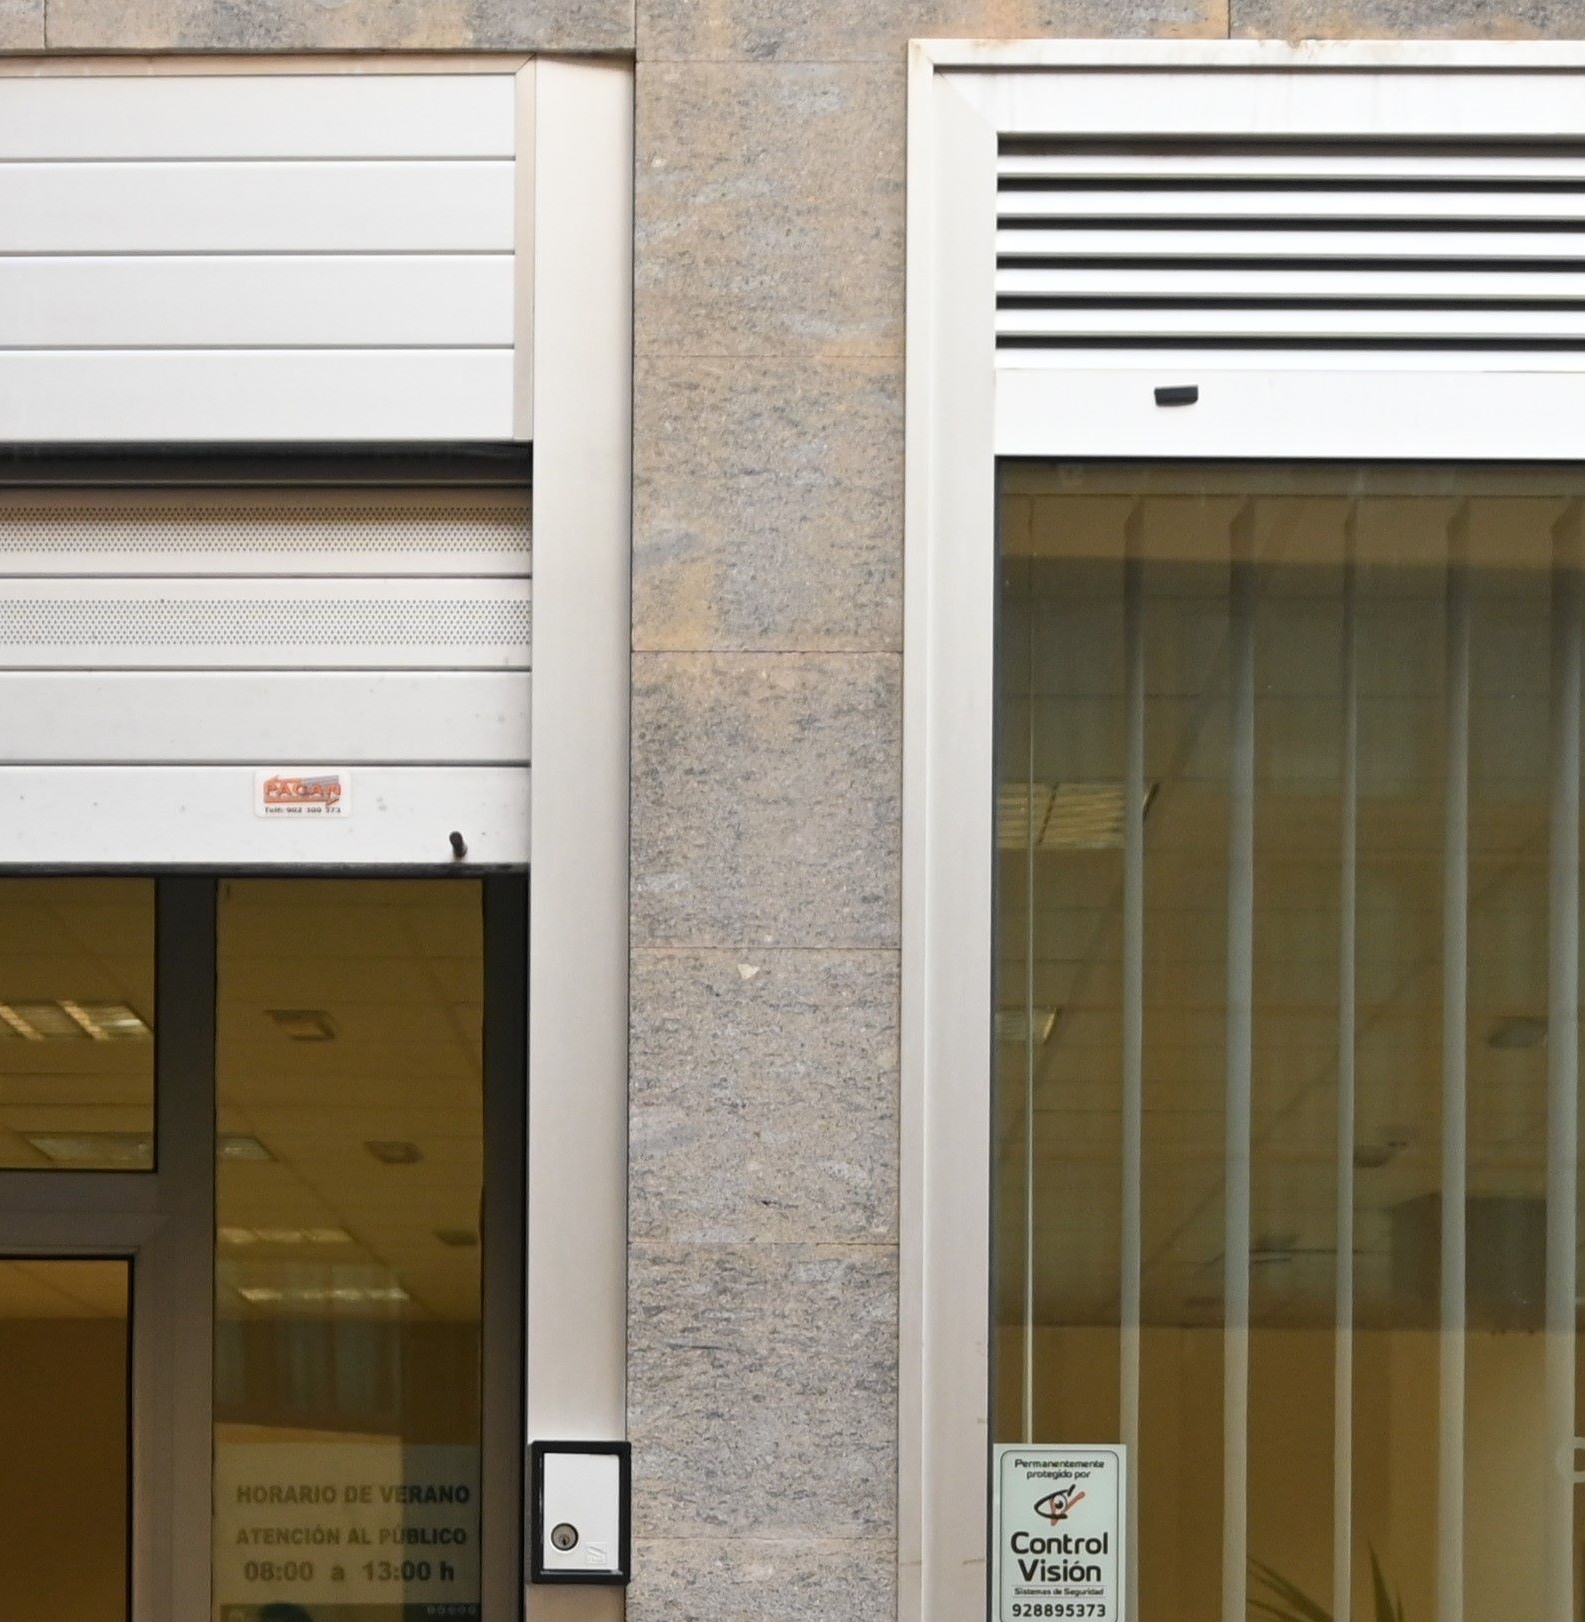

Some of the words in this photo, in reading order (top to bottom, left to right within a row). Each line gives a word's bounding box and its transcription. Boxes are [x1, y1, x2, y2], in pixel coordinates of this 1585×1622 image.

[1014, 1458, 1105, 1468] Permanentemente
[1026, 1470, 1073, 1480] protegido
[1074, 1471, 1090, 1480] por
[236, 1485, 336, 1504] HORARIO
[344, 1485, 372, 1504] DE
[379, 1485, 470, 1504] VERANO
[236, 1523, 340, 1546] ATENCIÓN
[347, 1528, 371, 1546] AL
[379, 1524, 467, 1546] PÚBLICO
[1010, 1531, 1108, 1555] Control
[243, 1560, 313, 1582] 08:00
[330, 1565, 345, 1582] a
[363, 1560, 431, 1582] 13:00
[440, 1560, 454, 1581] h
[1018, 1558, 1101, 1582] Visión
[1015, 1587, 1051, 1596] Sistemas
[1053, 1587, 1062, 1596] de
[1064, 1587, 1104, 1597] Seguridad
[1012, 1604, 1106, 1617] 928895373
